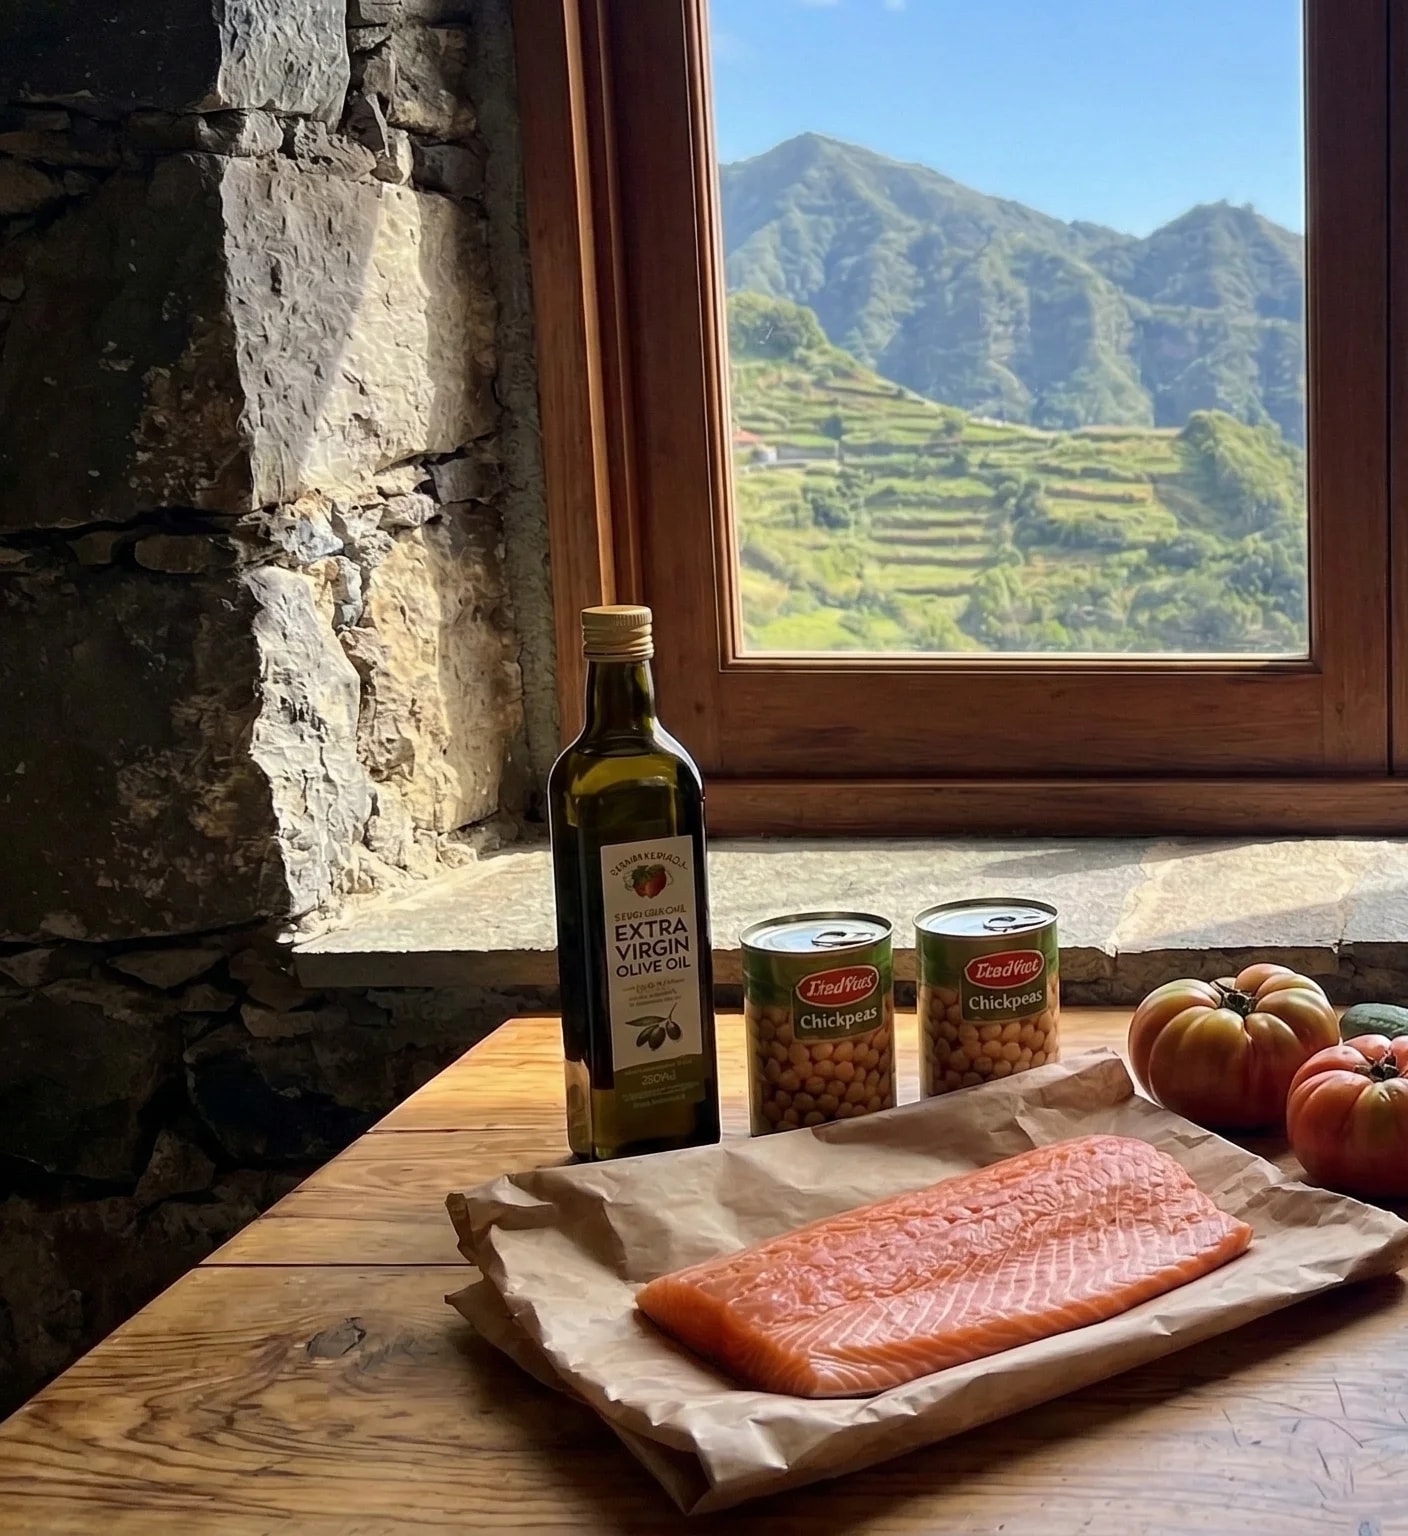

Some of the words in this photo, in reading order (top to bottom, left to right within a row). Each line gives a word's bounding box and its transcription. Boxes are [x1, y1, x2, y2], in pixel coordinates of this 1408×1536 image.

[615, 917, 688, 942] EXTRA
[615, 936, 690, 961] VIRGIN
[616, 960, 662, 978] OLIVE
[666, 955, 691, 971] OIL
[969, 990, 1043, 1011] Chickpeas
[800, 1006, 877, 1030] Chickpeas
